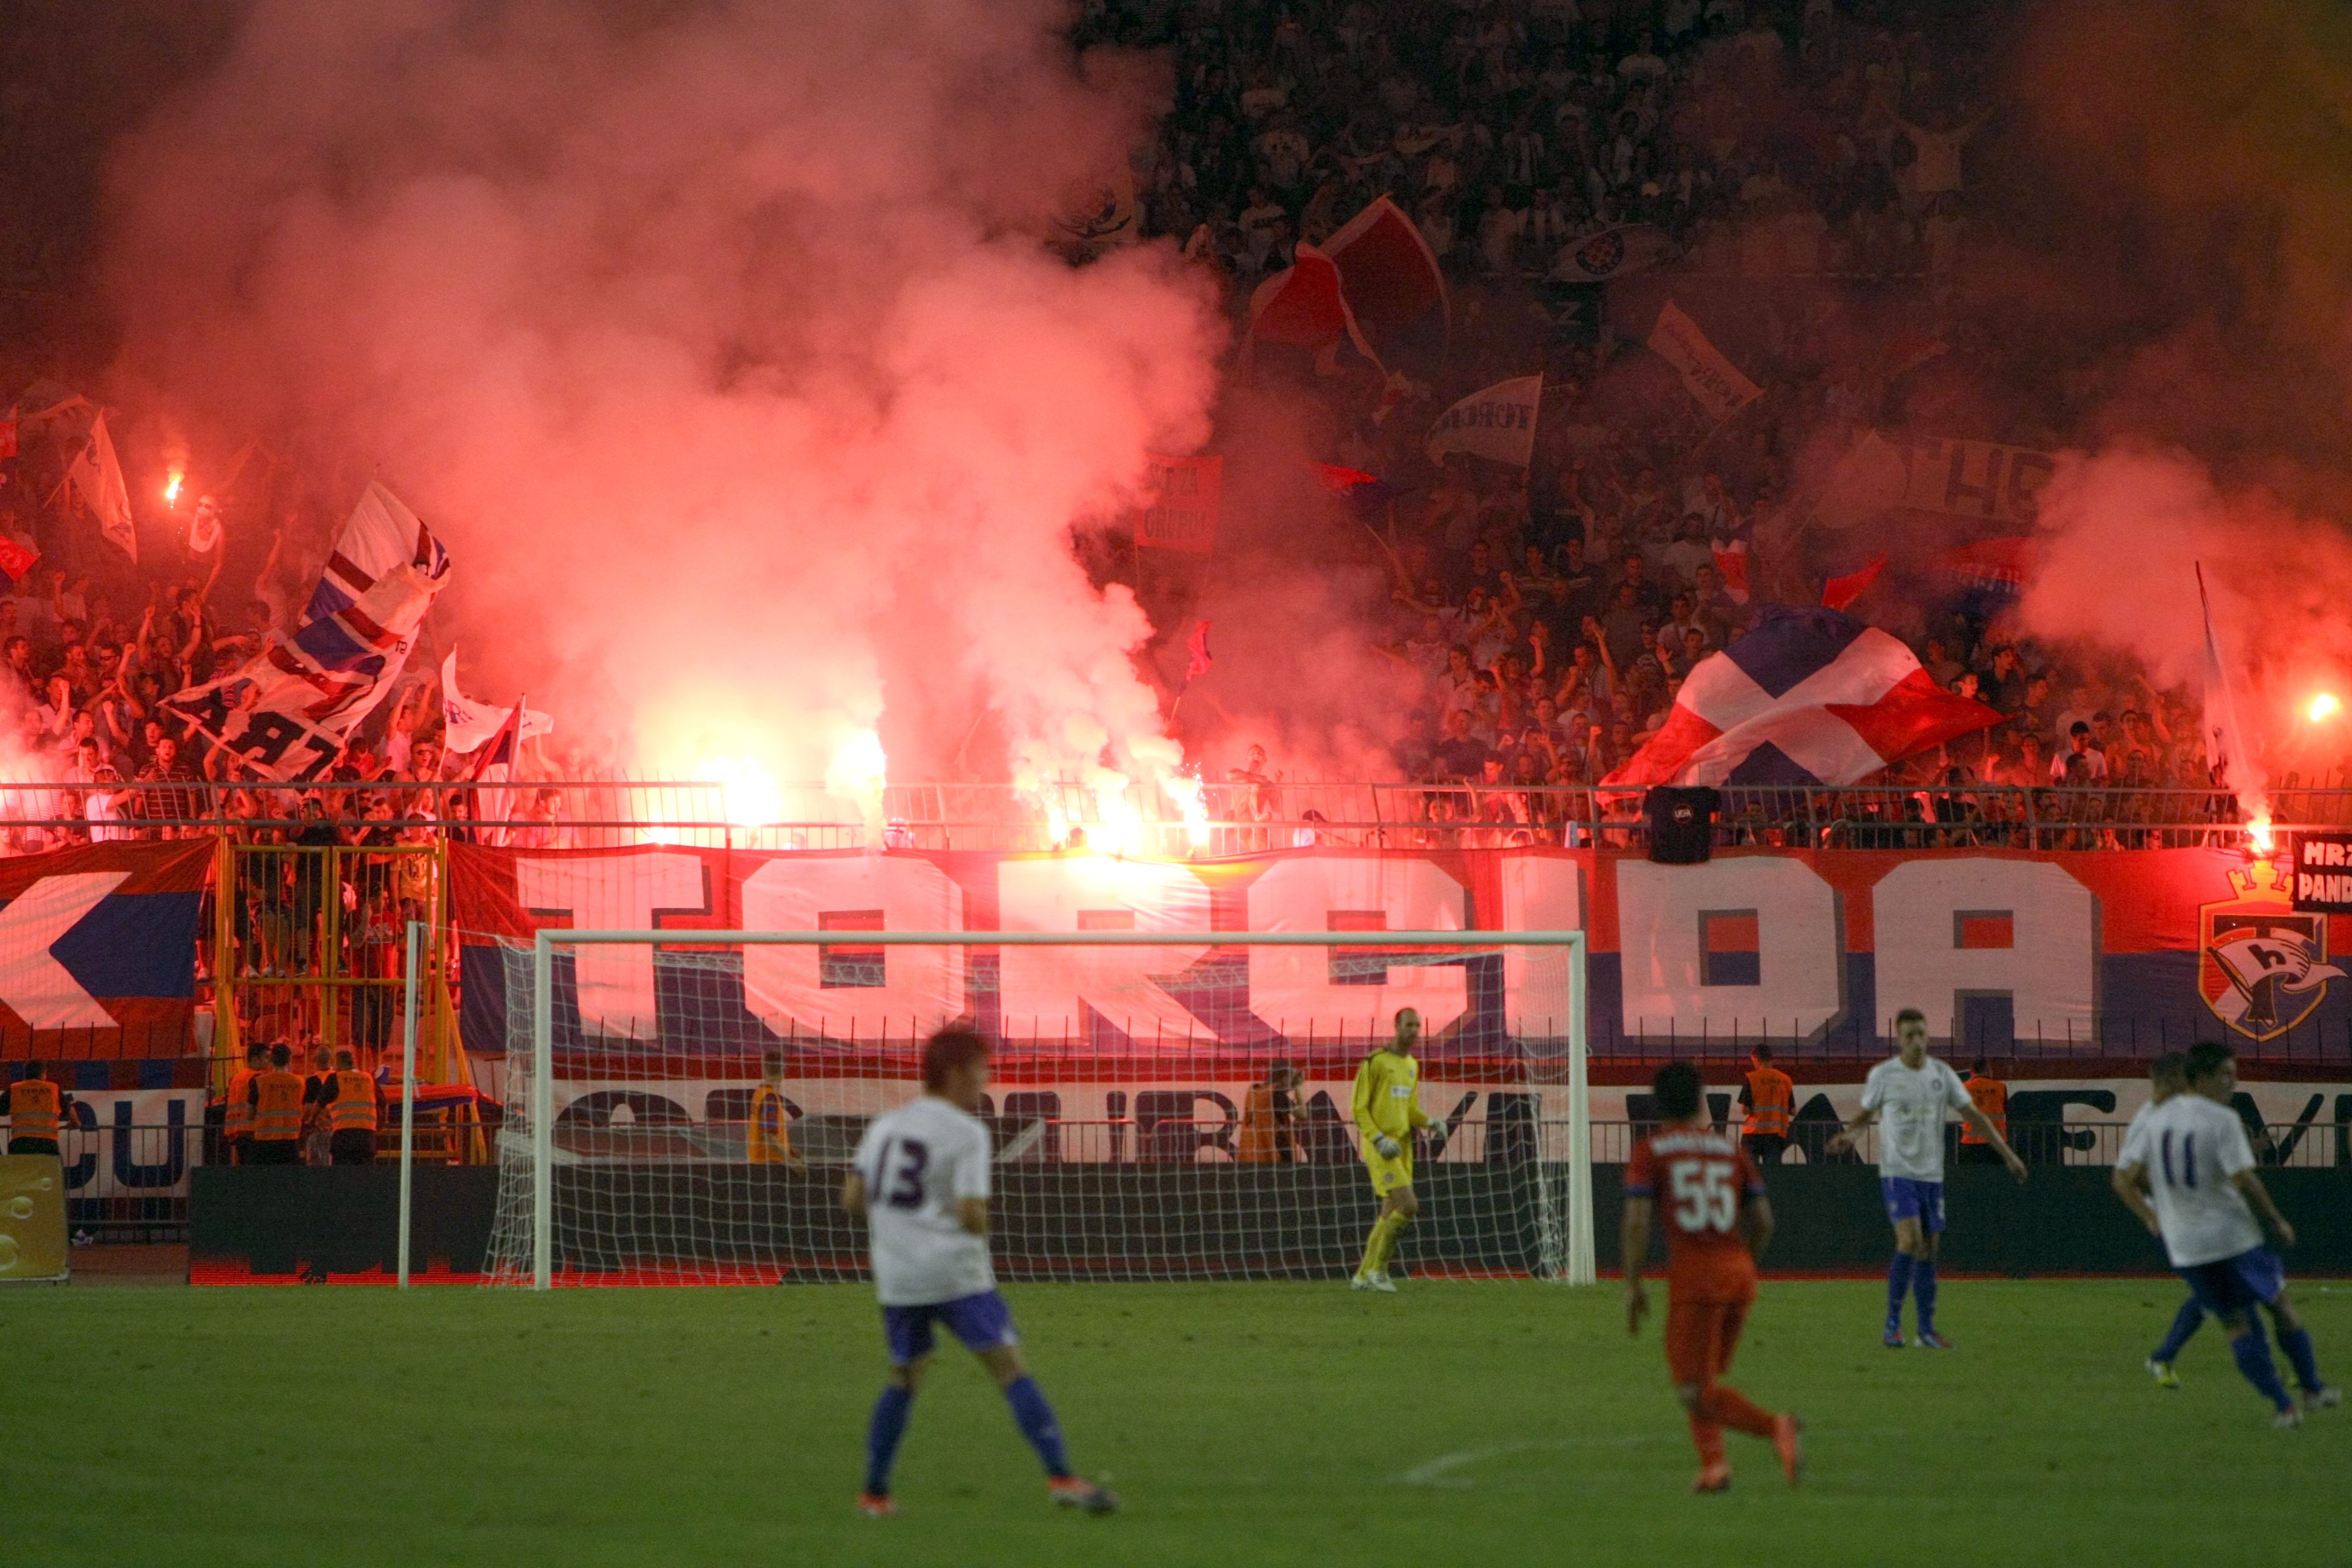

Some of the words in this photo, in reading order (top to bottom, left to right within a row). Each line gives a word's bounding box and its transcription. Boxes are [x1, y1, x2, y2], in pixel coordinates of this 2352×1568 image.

[516, 853, 2100, 1044] TORCIDA
[873, 1132, 928, 1210] 13
[2161, 1128, 2198, 1189] 11
[1670, 1160, 1736, 1233] 55
